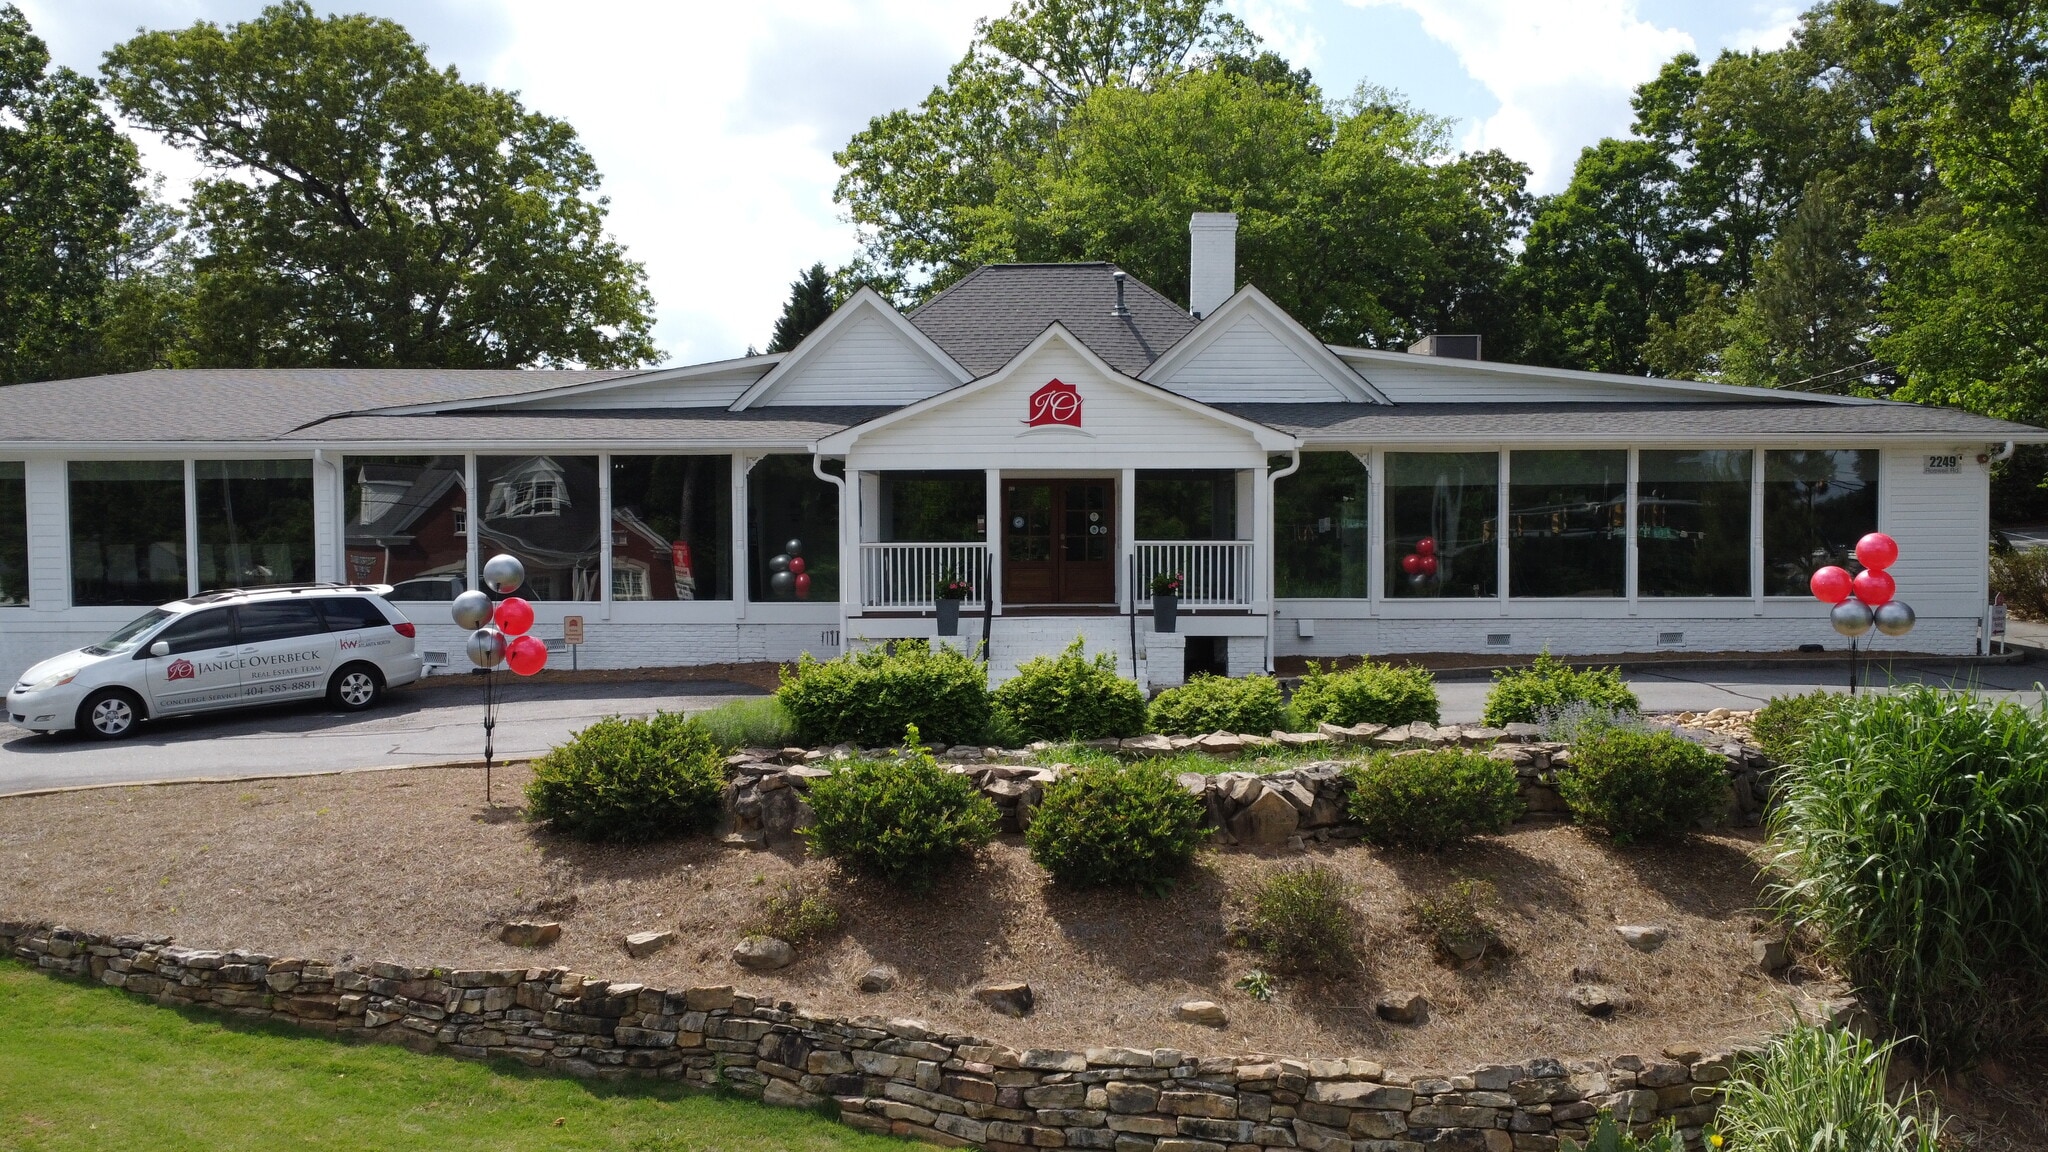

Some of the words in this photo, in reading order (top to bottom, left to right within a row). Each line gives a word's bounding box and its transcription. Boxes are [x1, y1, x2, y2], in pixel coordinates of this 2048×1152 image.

[1929, 456, 1956, 467] 2249
[340, 639, 357, 650] kw
[198, 659, 246, 675] JANICE
[249, 651, 320, 667] OVERBECK
[251, 671, 271, 679] REAL
[272, 668, 299, 677] ESTATE
[300, 665, 322, 674] TEAM
[244, 680, 316, 696] 404-585-8881
[160, 696, 206, 707] CONCIERGE
[208, 692, 238, 701] SERVICE
